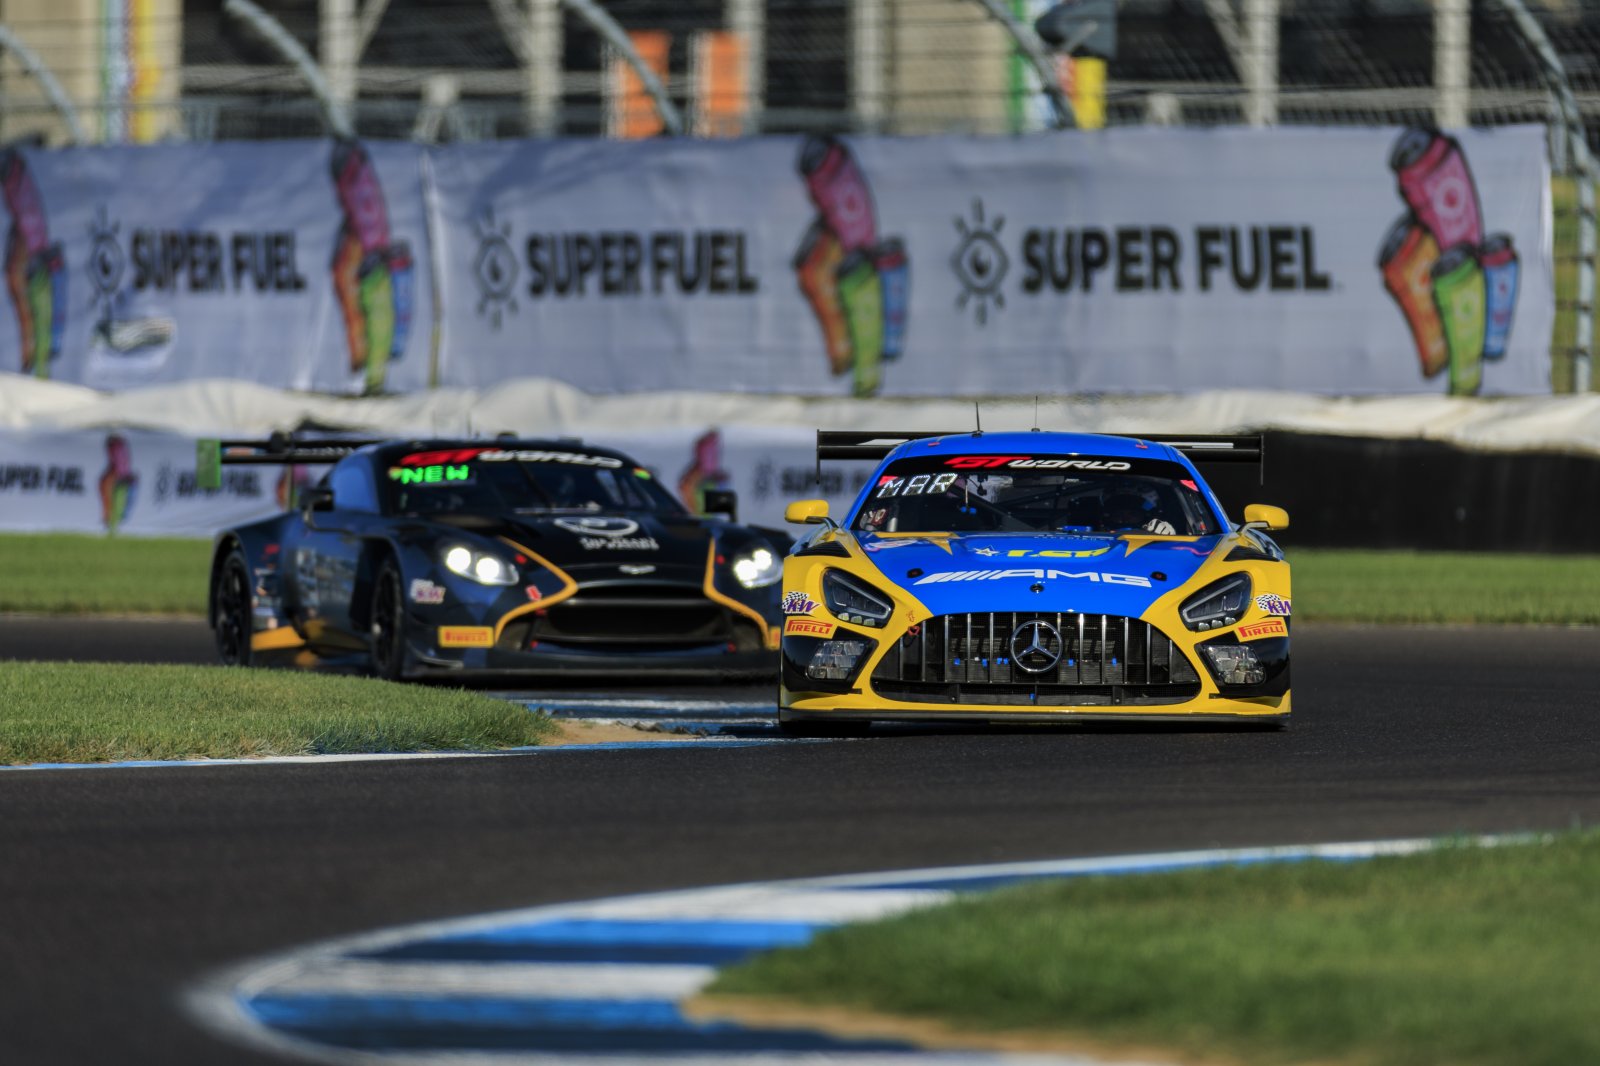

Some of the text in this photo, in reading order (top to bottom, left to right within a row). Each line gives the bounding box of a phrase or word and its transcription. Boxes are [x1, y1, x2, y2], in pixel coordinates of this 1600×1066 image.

[131, 229, 307, 294] SUPER FUEL
[526, 229, 758, 296] SUPER FUEL
[1021, 225, 1331, 293] SUPER FUEL
[401, 465, 469, 484] NEW
[876, 472, 958, 498] MAR
[990, 568, 1153, 588] AMG
[786, 599, 820, 613] KW
[786, 619, 833, 635] PIRELLI
[1238, 620, 1285, 638] PIRELLI
